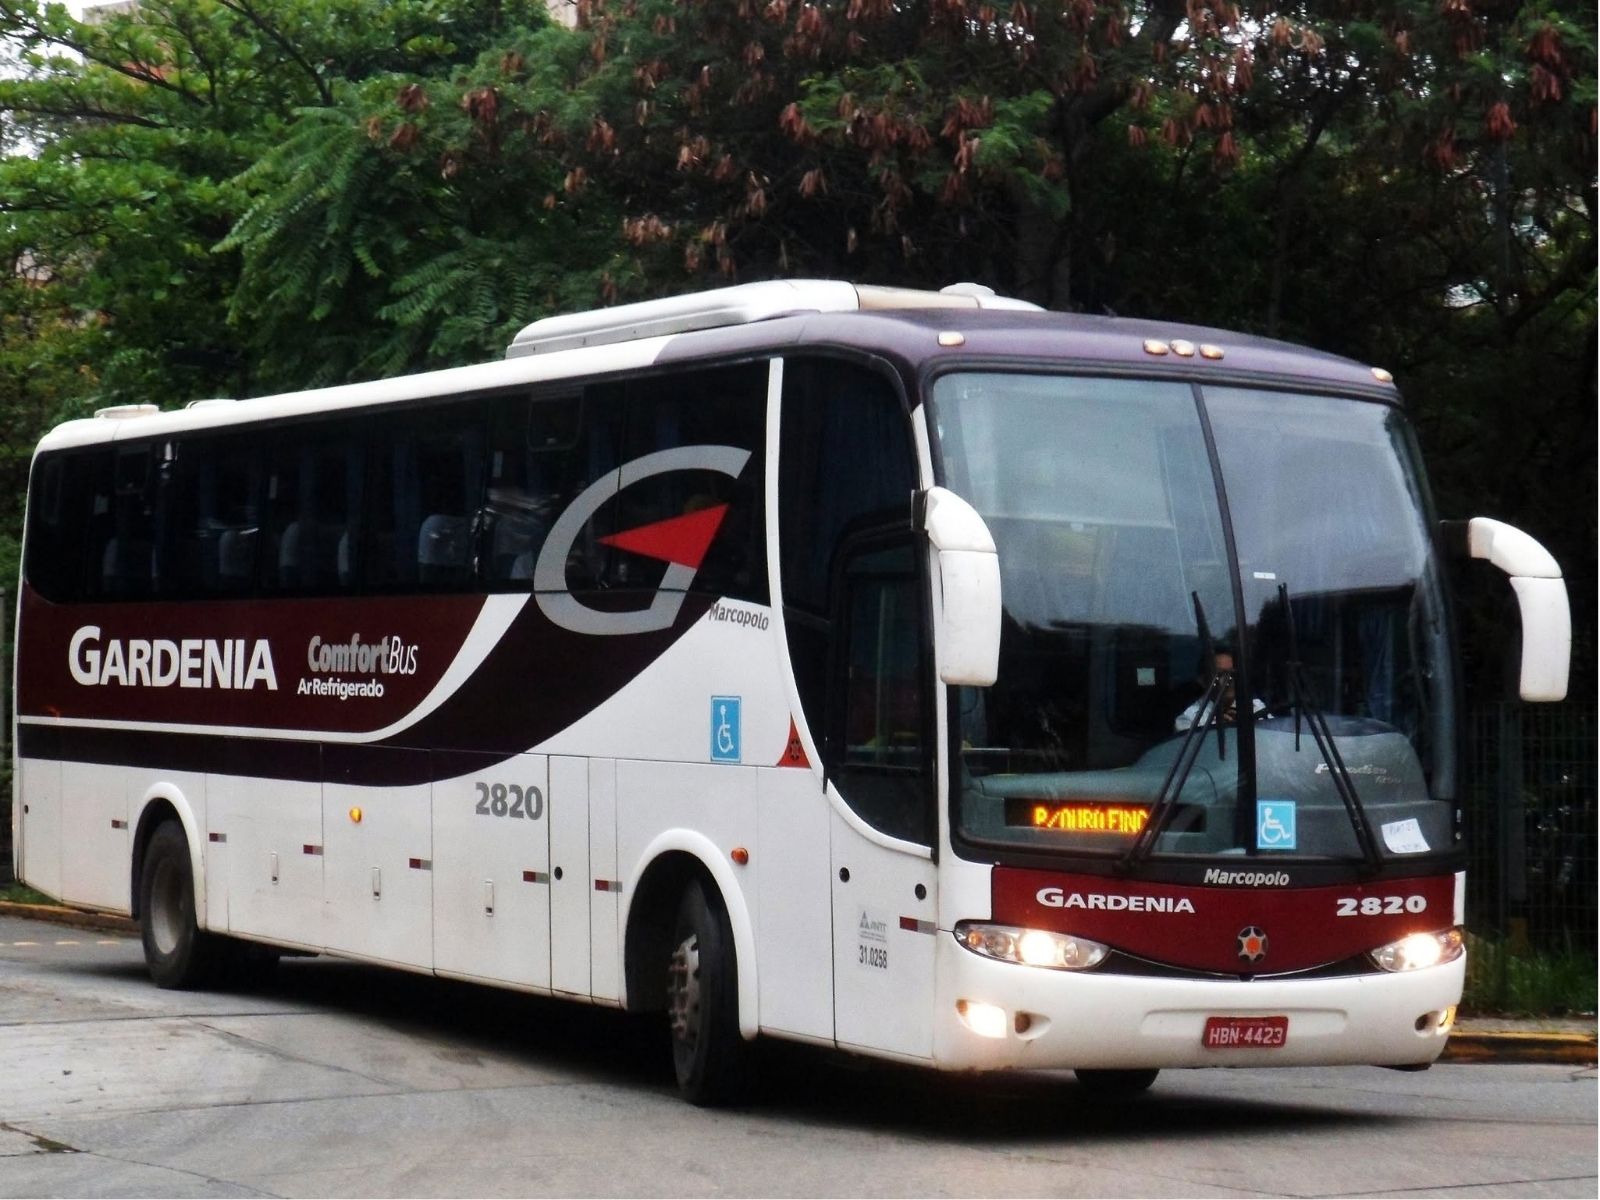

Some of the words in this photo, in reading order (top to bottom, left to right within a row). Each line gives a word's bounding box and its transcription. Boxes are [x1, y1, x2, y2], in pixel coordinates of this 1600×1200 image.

[708, 602, 769, 631] Marcopolo
[68, 625, 278, 690] GARDENIA
[475, 782, 543, 820] 2820
[1203, 868, 1290, 887] Marcopolo
[1035, 887, 1195, 914] GARDENIA
[1336, 895, 1427, 916] 2820
[859, 944, 887, 969] 31.0258
